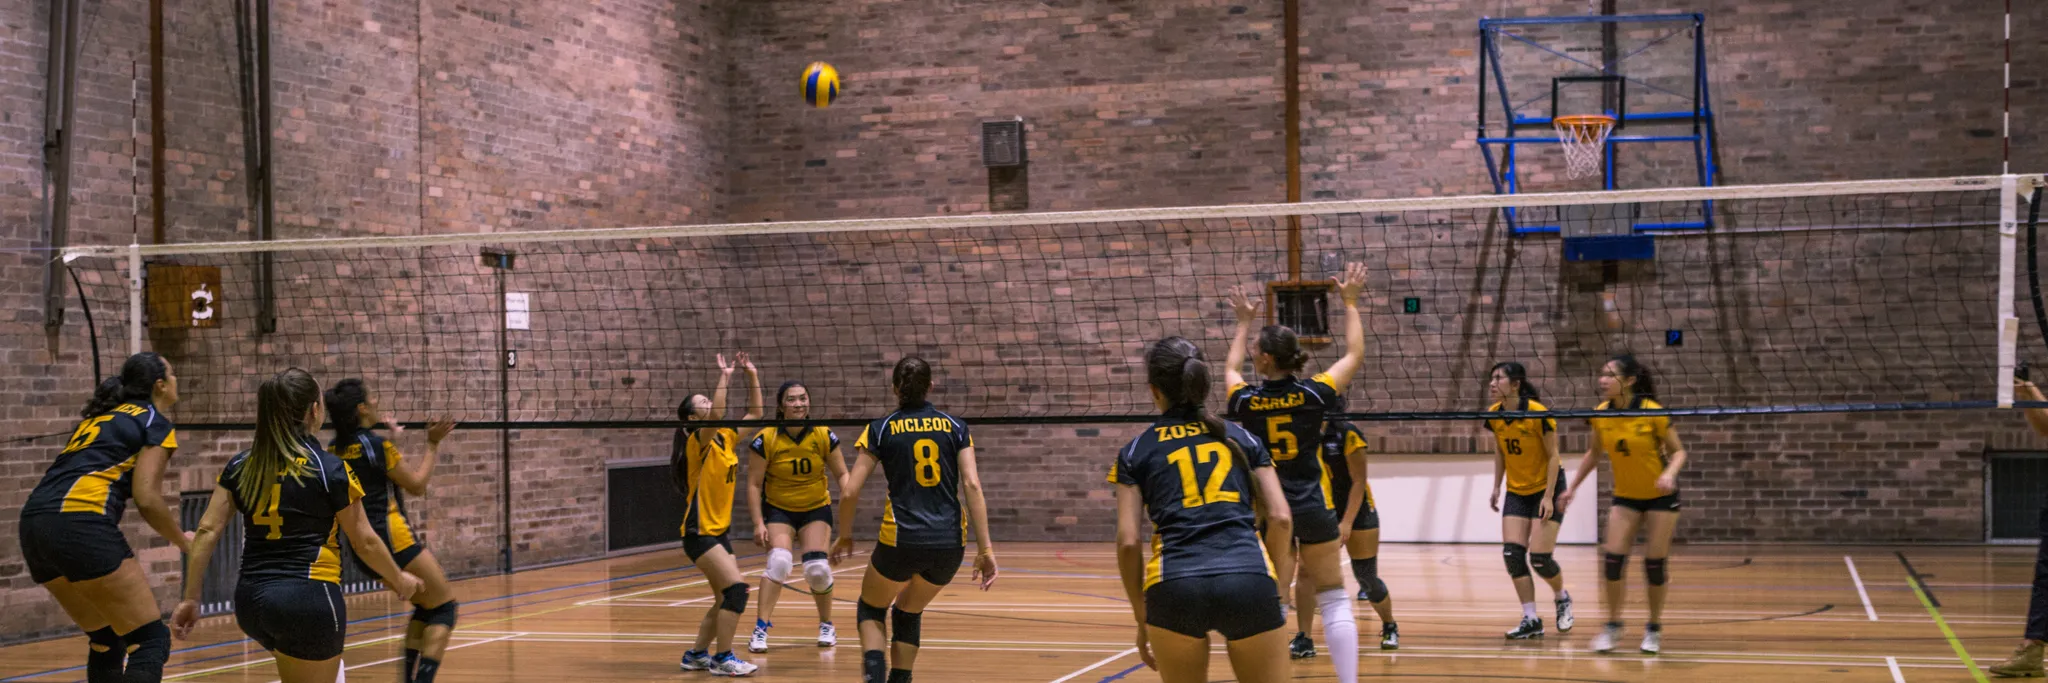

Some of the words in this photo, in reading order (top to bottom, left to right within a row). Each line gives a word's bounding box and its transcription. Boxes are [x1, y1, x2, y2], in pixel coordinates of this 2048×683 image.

[889, 416, 952, 435] MCLEOD
[1266, 414, 1299, 461] 5
[913, 438, 941, 487] 8
[1504, 438, 1523, 455] 16
[1615, 438, 1631, 457] 4
[790, 457, 812, 475] 10
[1166, 441, 1240, 508] 12
[252, 483, 284, 540] 4
